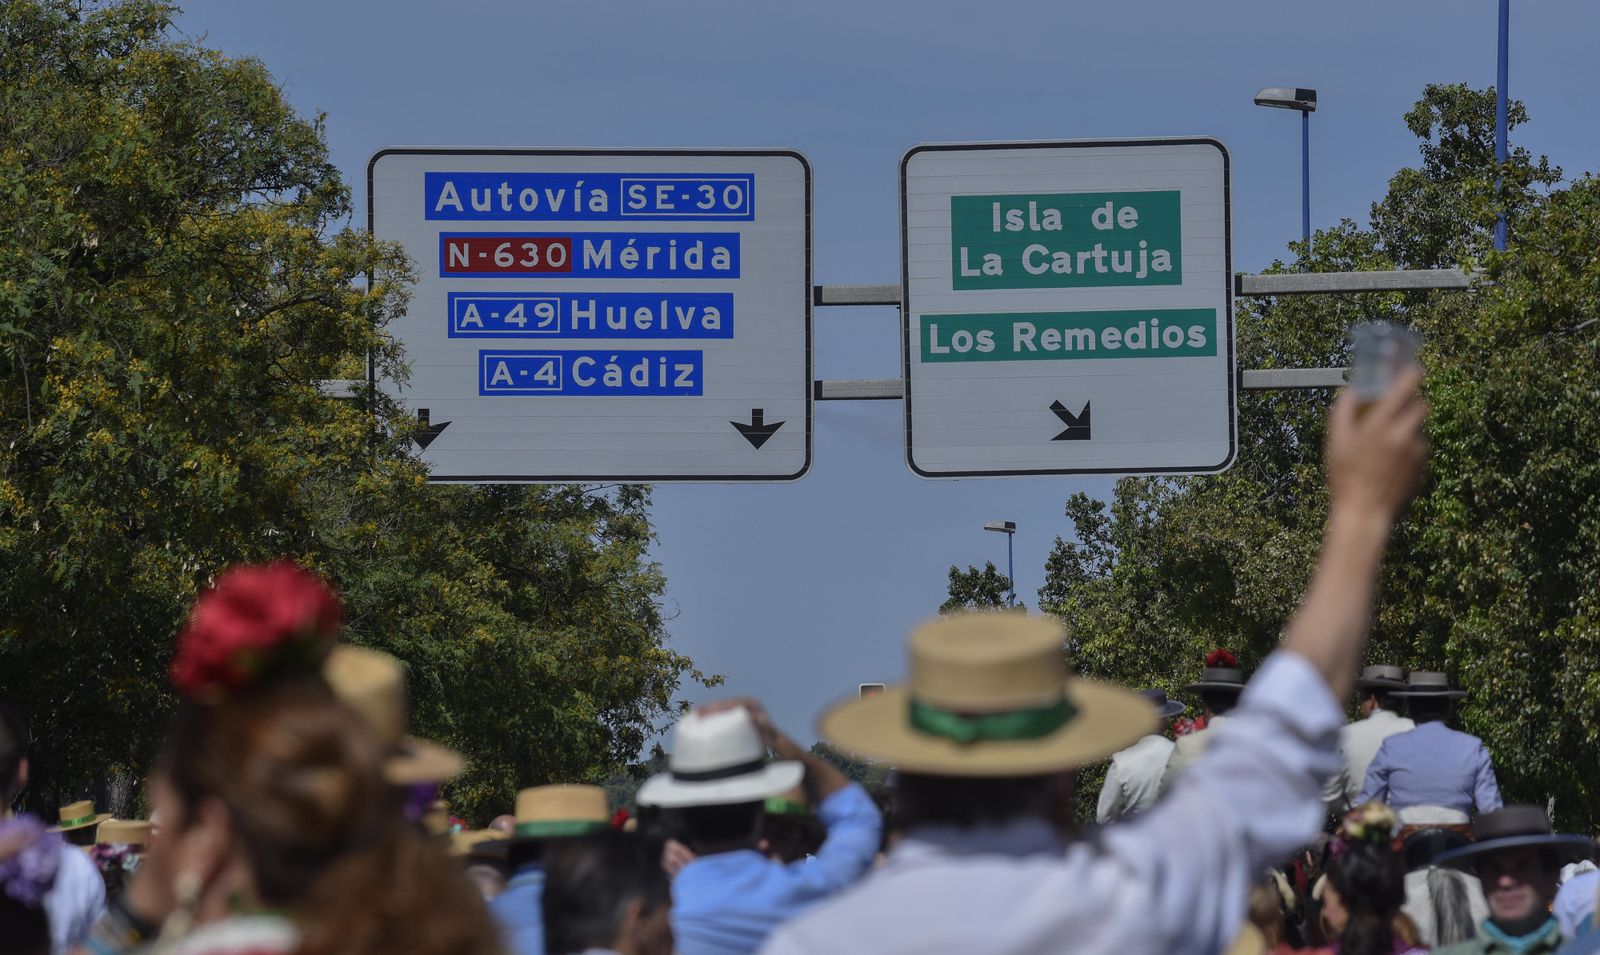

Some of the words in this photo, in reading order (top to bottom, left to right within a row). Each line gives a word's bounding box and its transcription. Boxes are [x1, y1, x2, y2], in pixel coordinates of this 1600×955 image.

[434, 180, 608, 213] Autovía
[627, 184, 743, 210] SE-30
[992, 200, 1063, 233] Isla
[1091, 201, 1139, 231] de
[449, 242, 567, 268] N-630
[583, 238, 731, 271] Mérida
[960, 246, 1004, 277] La
[1021, 239, 1173, 279] Cartuja
[460, 302, 555, 328] A-49
[571, 299, 721, 330] Huelva
[929, 323, 996, 354] Los
[1012, 317, 1207, 352] Remedios
[490, 360, 557, 386] A-4
[572, 355, 694, 388] Cádiz
